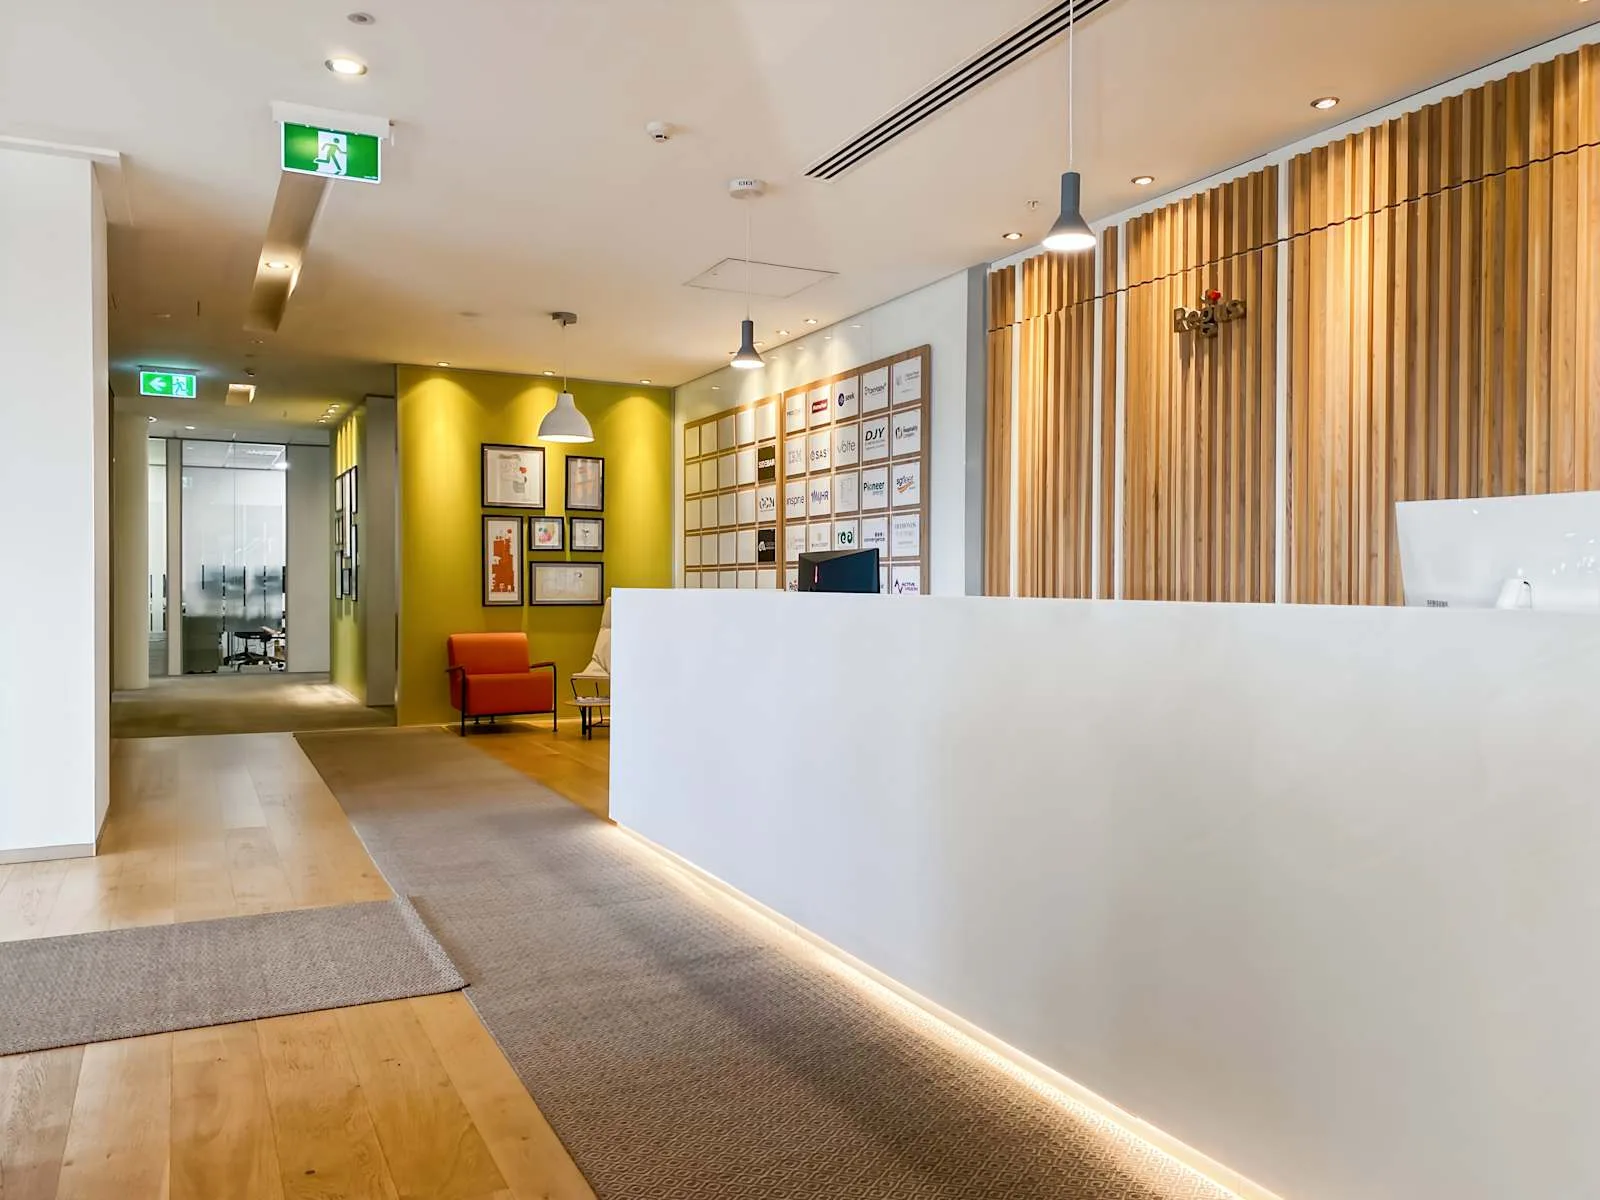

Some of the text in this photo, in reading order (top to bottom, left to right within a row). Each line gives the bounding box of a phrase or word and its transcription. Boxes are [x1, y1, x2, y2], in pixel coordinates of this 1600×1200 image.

[865, 427, 884, 441] DJY
[863, 482, 885, 492] Pioneer
[837, 528, 855, 545] real
